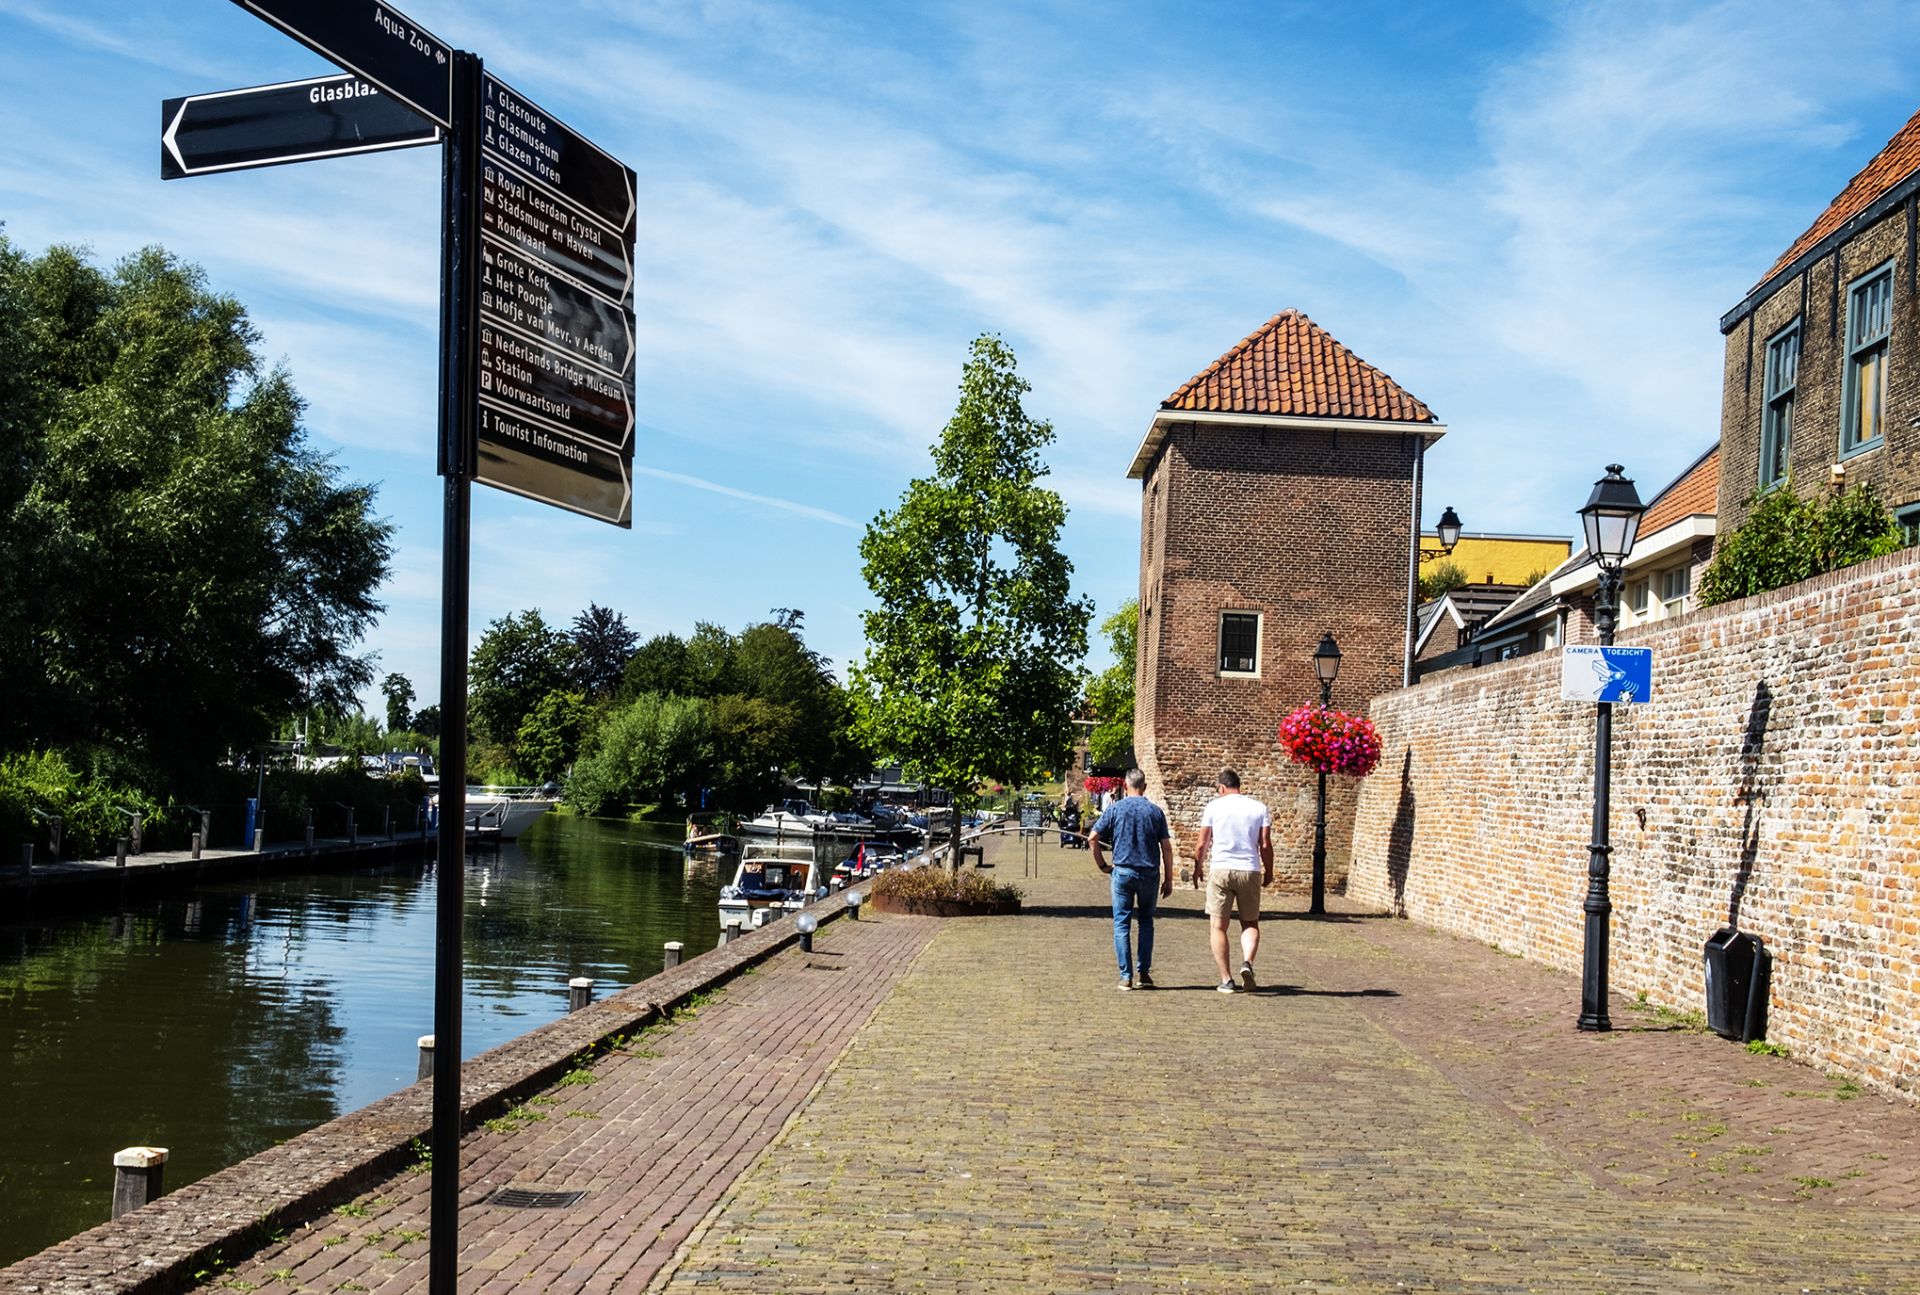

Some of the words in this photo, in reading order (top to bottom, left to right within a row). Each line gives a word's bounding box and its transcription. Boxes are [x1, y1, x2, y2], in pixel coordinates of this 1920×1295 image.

[374, 7, 405, 40] Aqua
[409, 30, 431, 57] Zoo
[499, 91, 547, 134] Glasroute
[498, 112, 559, 163] Glasmuseum
[498, 134, 532, 167] Glazen
[535, 156, 561, 184] Toren
[497, 194, 549, 235] Stadsmuur
[552, 228, 563, 240] en
[567, 235, 593, 260] Haven
[498, 172, 526, 201] Royal
[528, 190, 568, 225] Leerdam
[570, 216, 601, 246] Crystal
[497, 214, 547, 255] Rondvaart
[496, 253, 525, 279] Grote
[528, 268, 550, 292] Kerk
[496, 274, 514, 293] Het
[517, 284, 553, 315] Poortje
[496, 294, 524, 322] Hofje
[527, 313, 544, 330] van
[547, 321, 572, 344] Mevr.
[574, 336, 581, 347] v
[583, 338, 614, 363] Aerden
[495, 334, 550, 371] Nederlands
[554, 360, 583, 386] Bridge
[586, 374, 621, 400] Museum
[495, 356, 533, 384] Station
[496, 377, 571, 420] Voorwaartsveld
[494, 415, 530, 443] Tourist
[533, 430, 588, 463] Information
[1606, 648, 1644, 656] TOEZICHT
